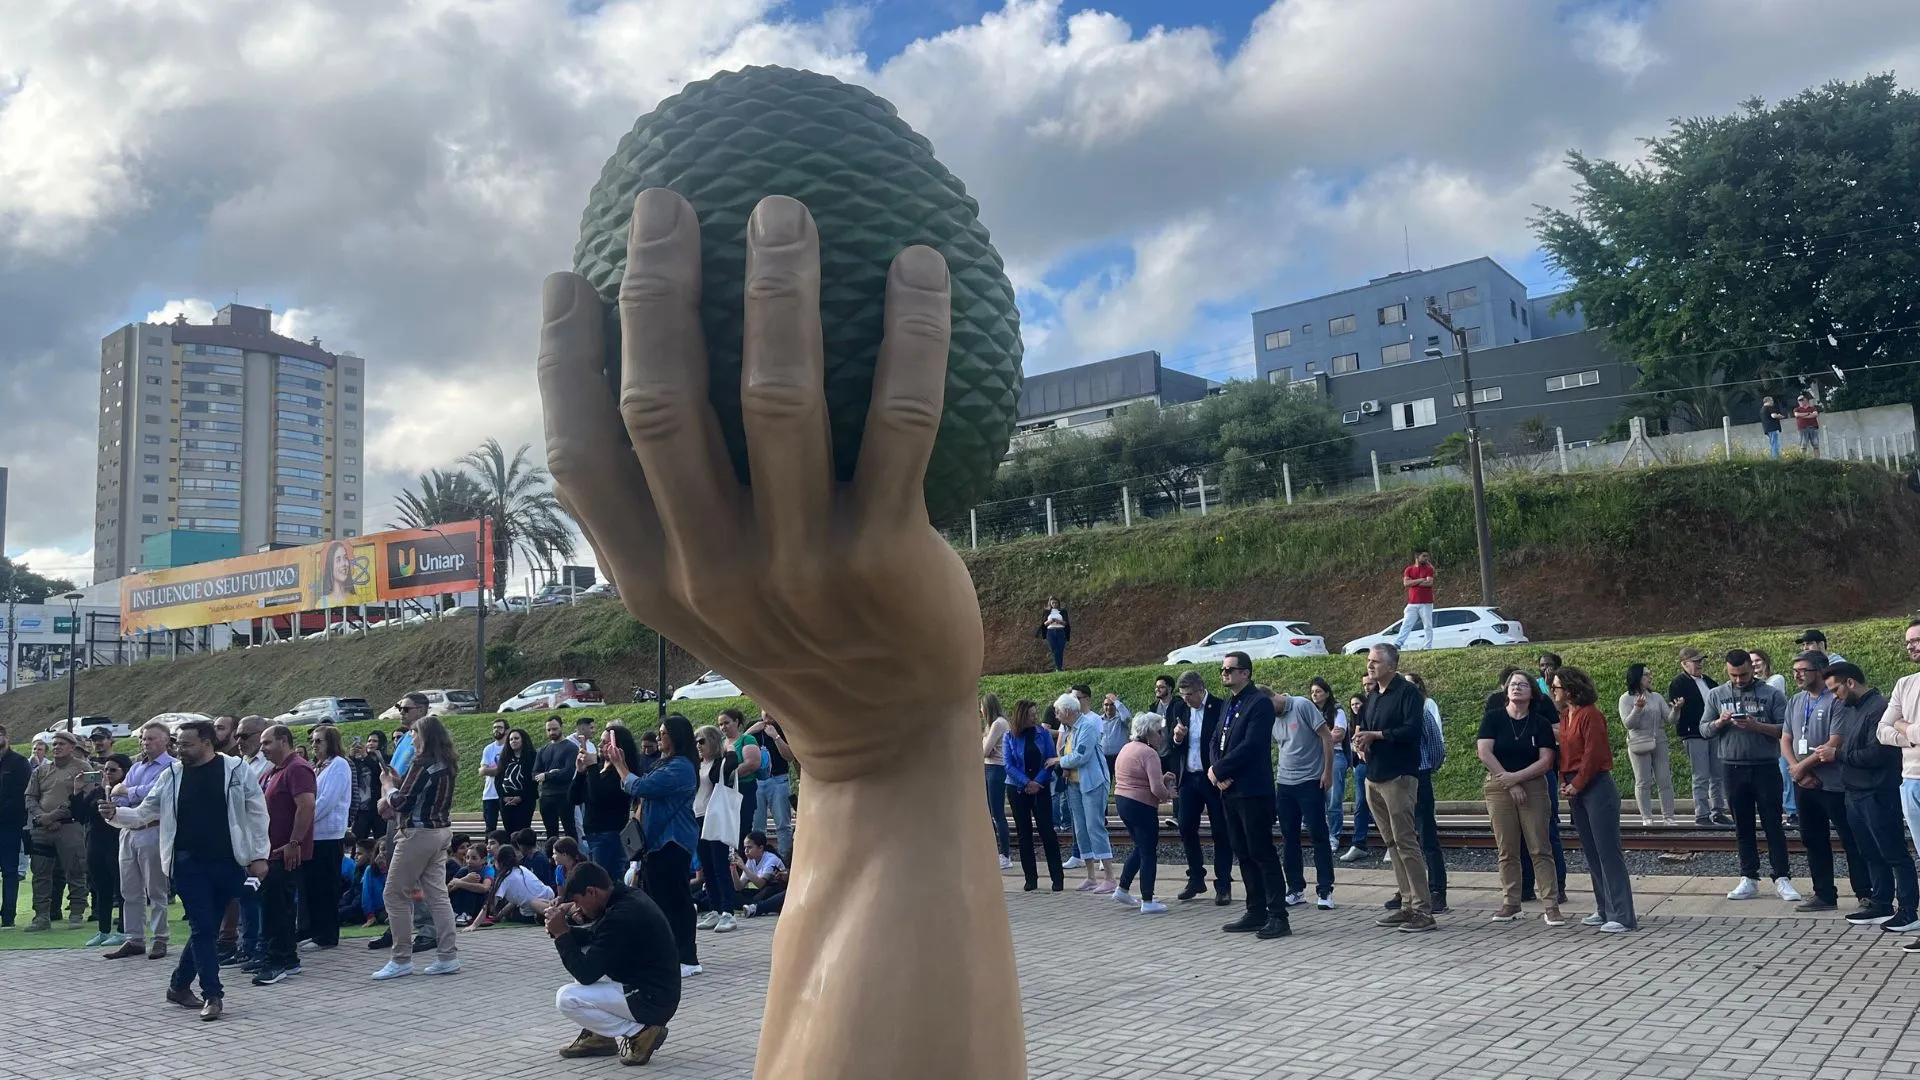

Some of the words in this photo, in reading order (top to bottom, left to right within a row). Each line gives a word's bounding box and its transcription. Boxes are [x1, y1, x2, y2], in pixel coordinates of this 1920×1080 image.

[419, 553, 465, 571] Uniarp
[133, 582, 202, 608] INFLUENCIE
[204, 580, 214, 597] O
[215, 576, 240, 596] SEU
[242, 567, 295, 592] FUTURO
